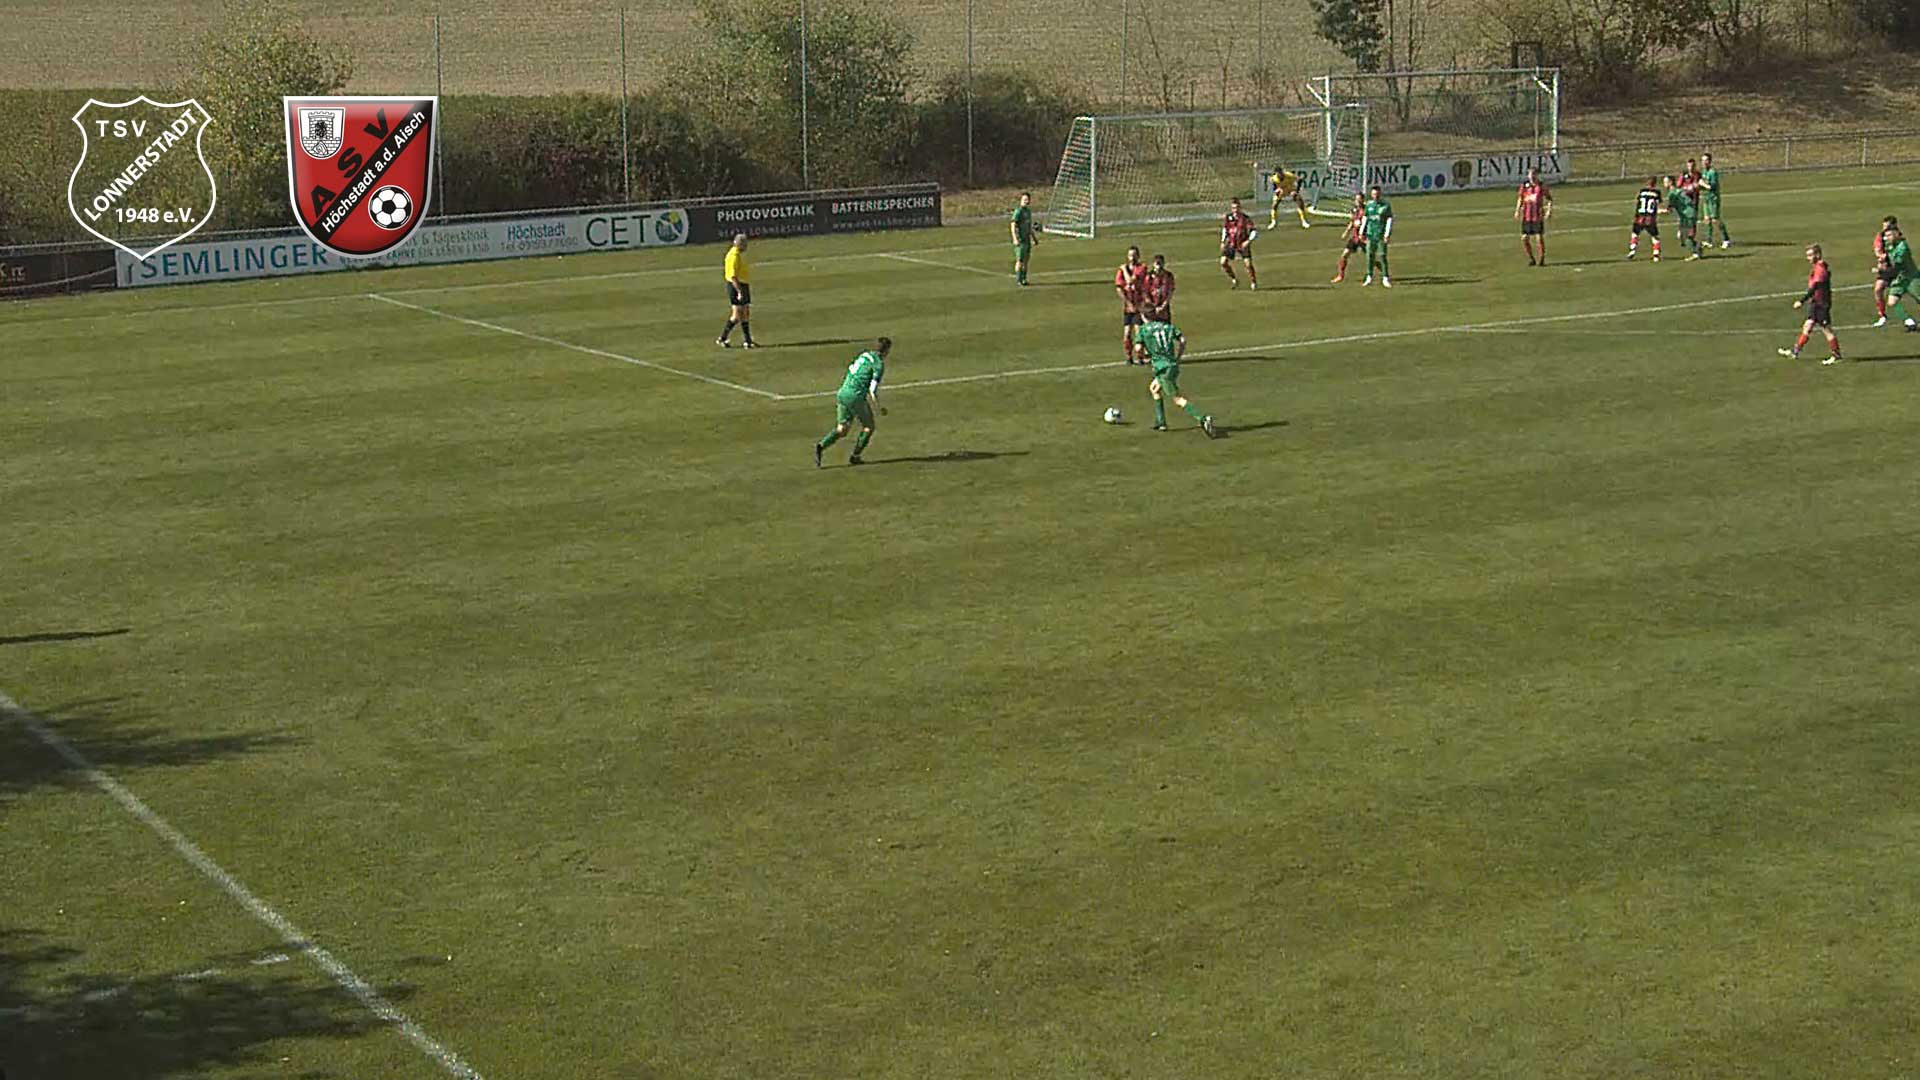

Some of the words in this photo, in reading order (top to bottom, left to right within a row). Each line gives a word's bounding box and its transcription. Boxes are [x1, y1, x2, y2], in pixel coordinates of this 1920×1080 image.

[717, 204, 815, 223] PHOTOVOLTAIK
[831, 196, 935, 214] BATTERIESPEICHER
[507, 222, 567, 242] Höchstadt
[586, 214, 652, 247] CET
[141, 242, 328, 280] SEMLINGER
